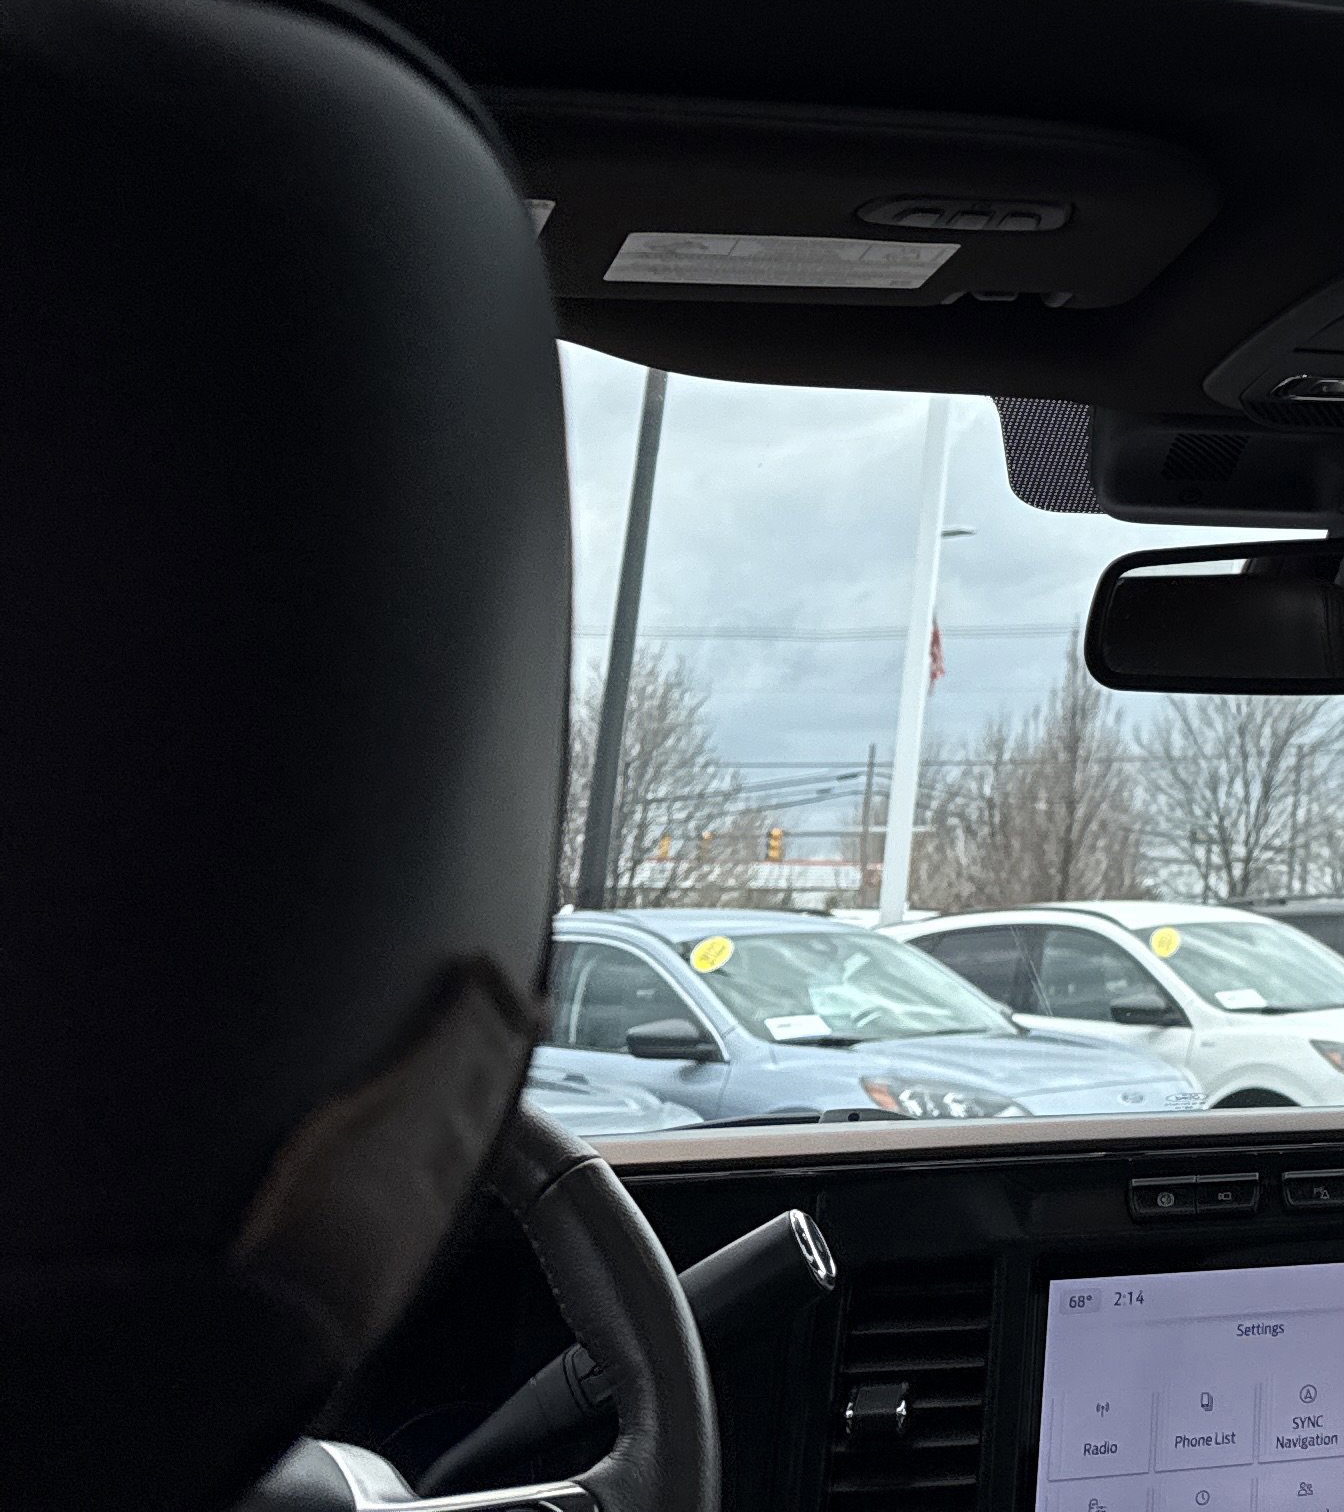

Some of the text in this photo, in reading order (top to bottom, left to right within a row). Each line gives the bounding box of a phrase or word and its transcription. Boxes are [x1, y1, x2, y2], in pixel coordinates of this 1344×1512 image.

[1113, 1290, 1145, 1307] 2:14
[1236, 1321, 1285, 1338] Settings
[1292, 1414, 1324, 1430] SYNC
[1174, 1430, 1237, 1449] Phone List
[1275, 1433, 1339, 1450] Navigation
[1083, 1440, 1118, 1457] Radio
